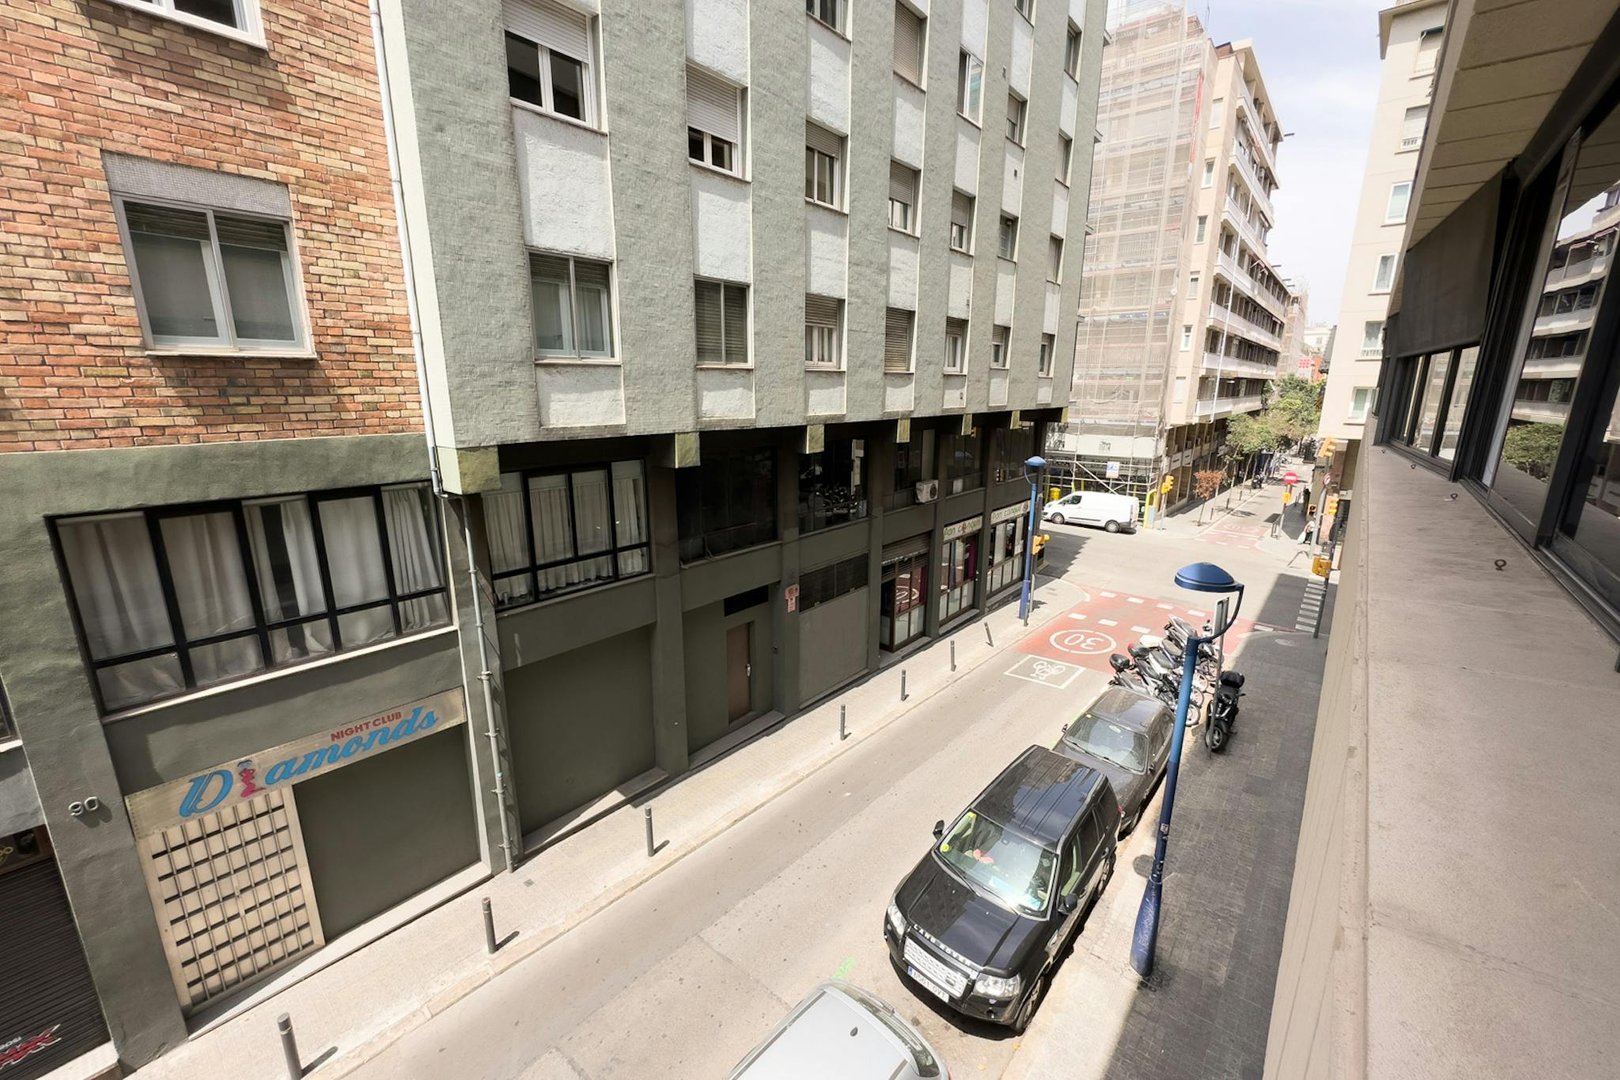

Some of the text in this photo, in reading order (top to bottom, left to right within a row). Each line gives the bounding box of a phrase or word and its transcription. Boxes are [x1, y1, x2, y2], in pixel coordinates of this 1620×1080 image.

[1064, 633, 1105, 650] 30
[913, 923, 972, 967] LAND ROVER
